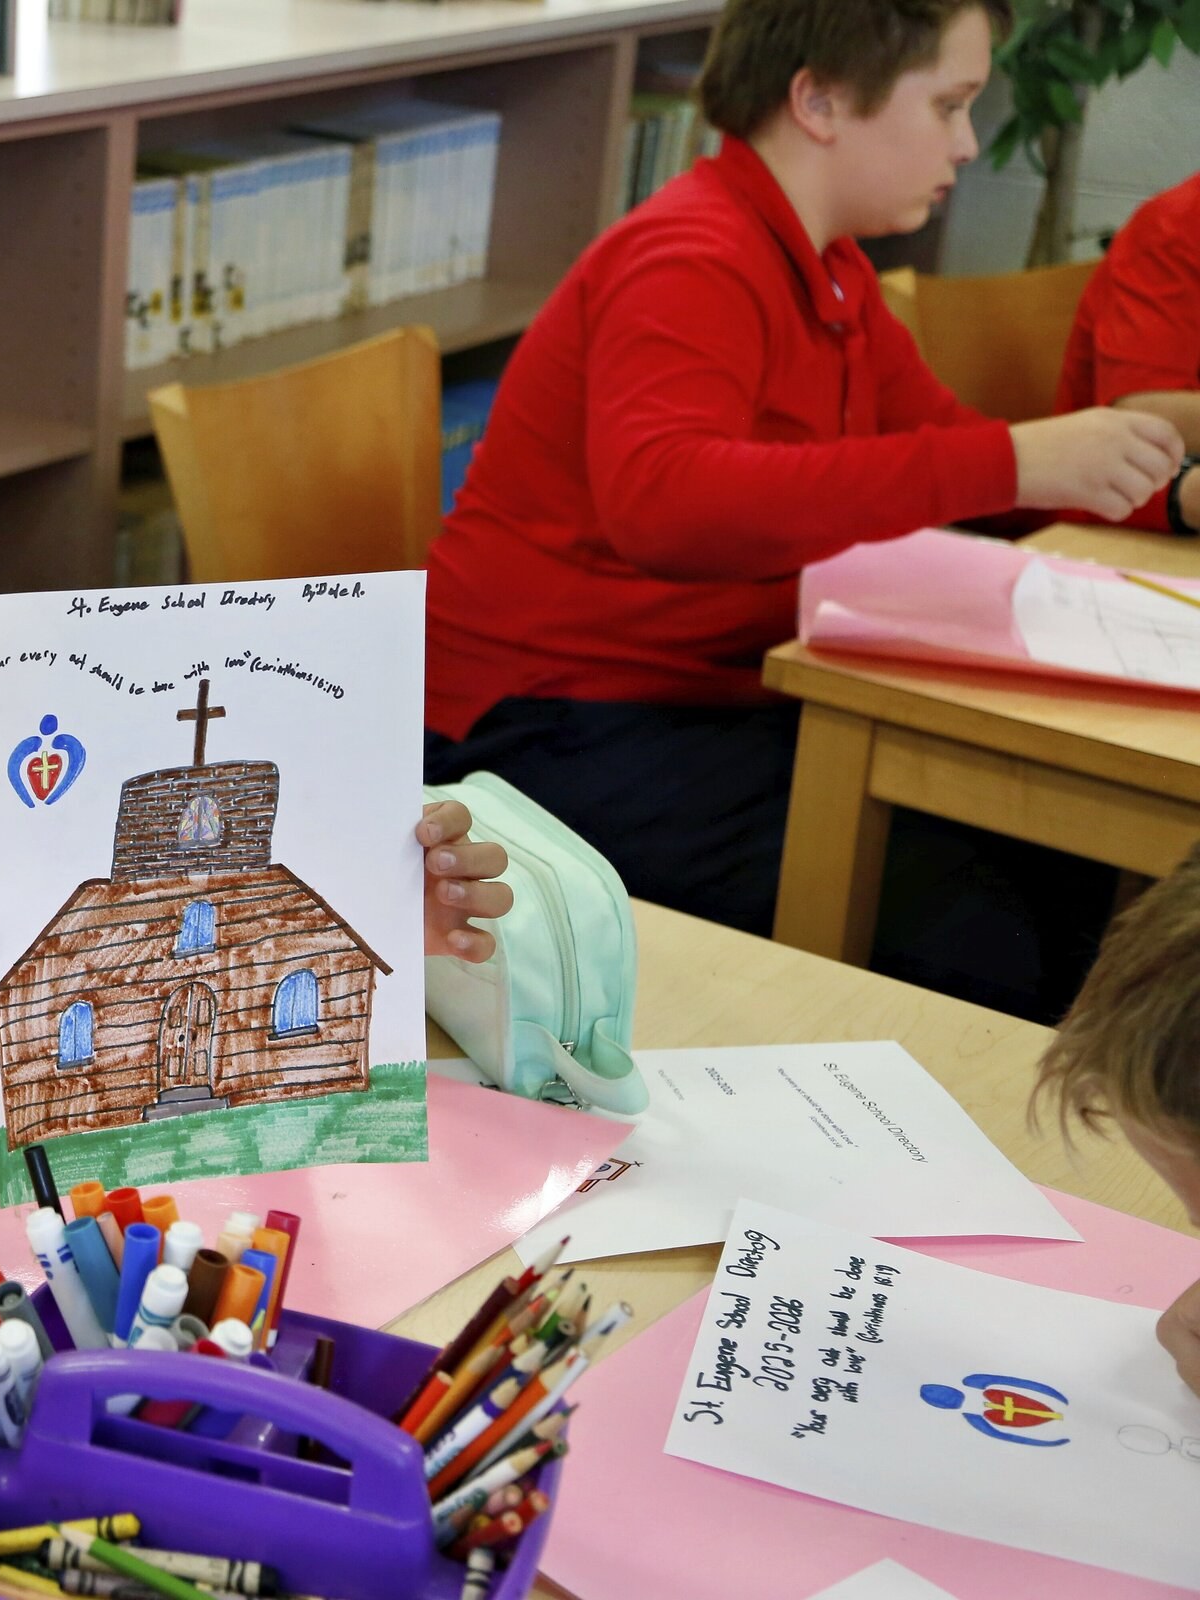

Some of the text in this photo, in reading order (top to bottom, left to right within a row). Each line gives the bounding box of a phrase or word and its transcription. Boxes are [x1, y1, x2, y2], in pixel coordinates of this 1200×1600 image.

[67, 597, 92, 618] St.
[98, 596, 151, 617] Eugene
[161, 592, 207, 610] School
[19, 650, 58, 667] every
[88, 663, 125, 691] should
[128, 683, 146, 695] be
[183, 660, 210, 680] with
[833, 1073, 867, 1101] Eugene
[862, 1101, 897, 1126] School
[887, 1127, 929, 1164] Directory
[834, 1255, 865, 1281] done
[829, 1286, 857, 1300] be
[716, 1291, 751, 1329] School
[827, 1310, 851, 1337] should
[752, 1295, 804, 1392] 2025-2026
[696, 1337, 752, 1393] Eugene
[683, 1400, 725, 1425] St.
